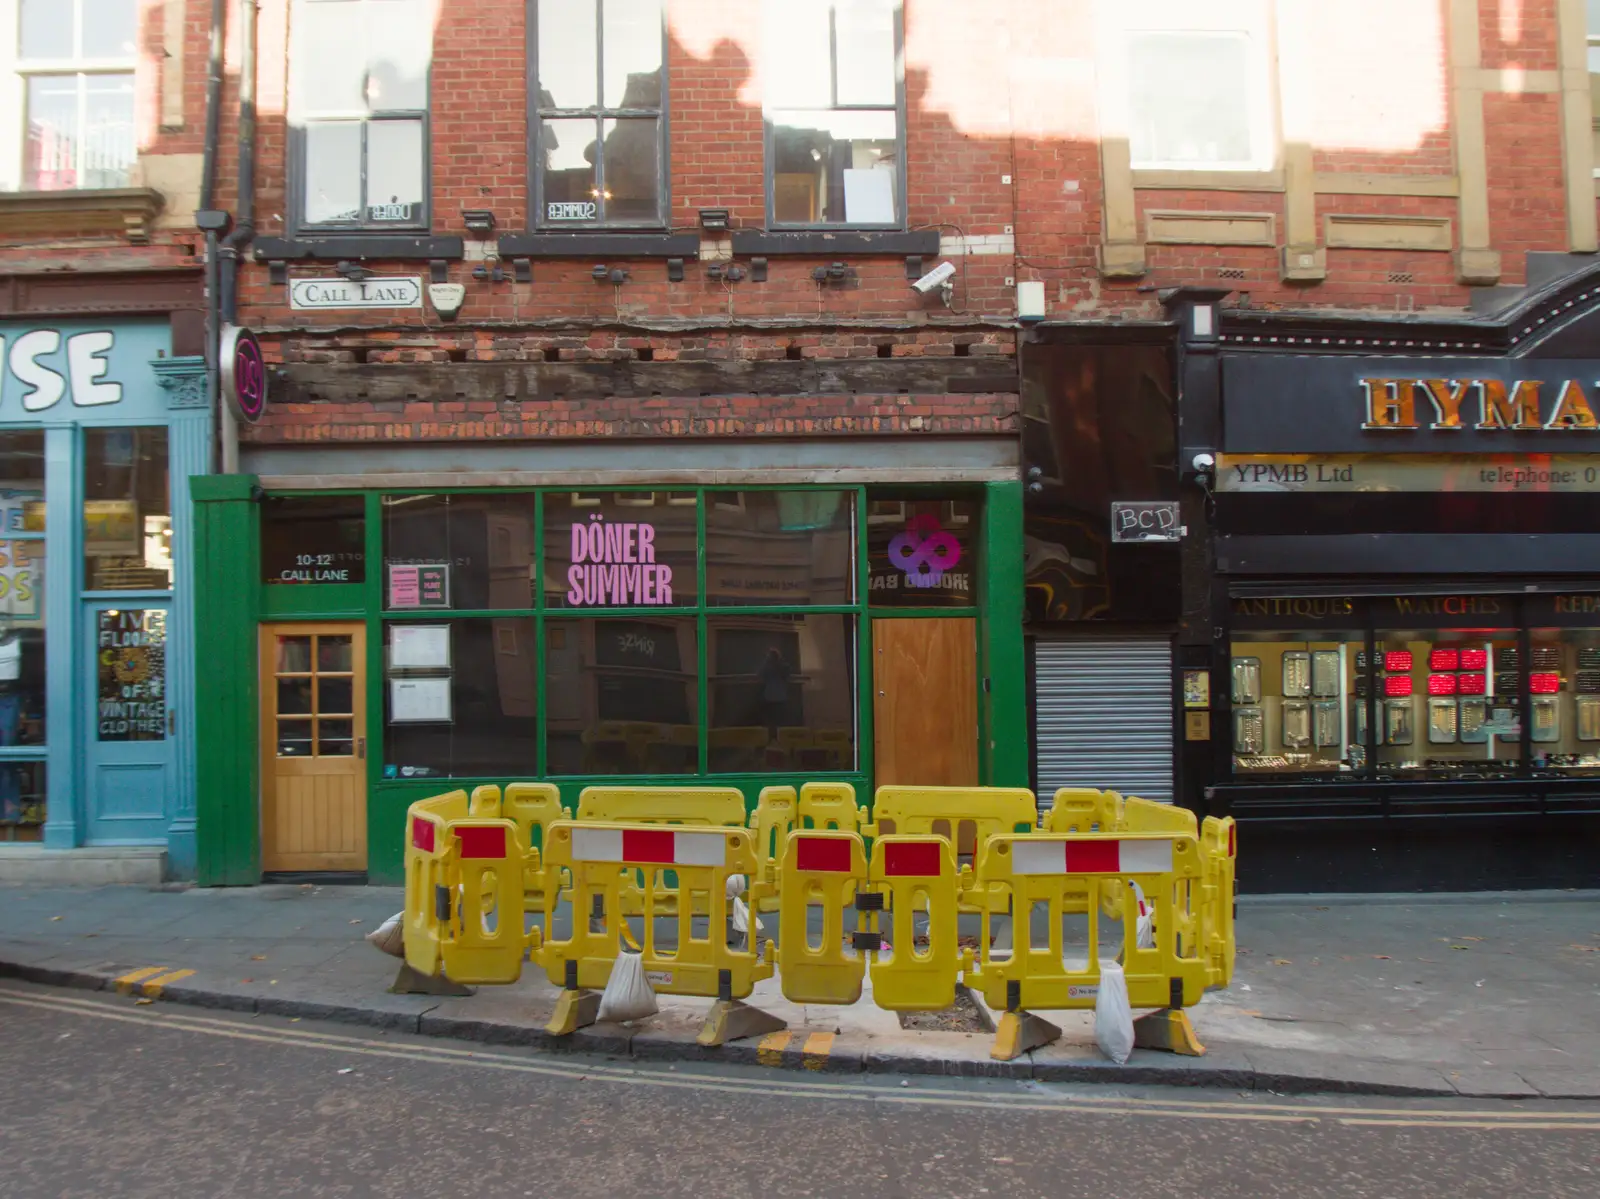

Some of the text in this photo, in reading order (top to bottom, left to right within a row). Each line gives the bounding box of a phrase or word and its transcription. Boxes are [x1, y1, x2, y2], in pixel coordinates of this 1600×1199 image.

[305, 283, 409, 302] CALL LANE
[0, 327, 123, 412] SE
[1358, 378, 1600, 430] HYMA
[1232, 463, 1354, 483] YPMB Ltd
[1480, 465, 1577, 488] telephone:
[1119, 508, 1174, 529] BCD
[571, 513, 655, 563] DÖNER
[296, 554, 331, 565] 10-12
[281, 569, 349, 581] CALL LANE
[567, 564, 673, 605] SUMMER
[1237, 598, 1353, 619] ANTIQUES
[1394, 597, 1500, 615] WATCHES
[122, 684, 142, 698] OF
[100, 701, 165, 718] VINTAGE
[100, 719, 165, 734] CLOTHES
